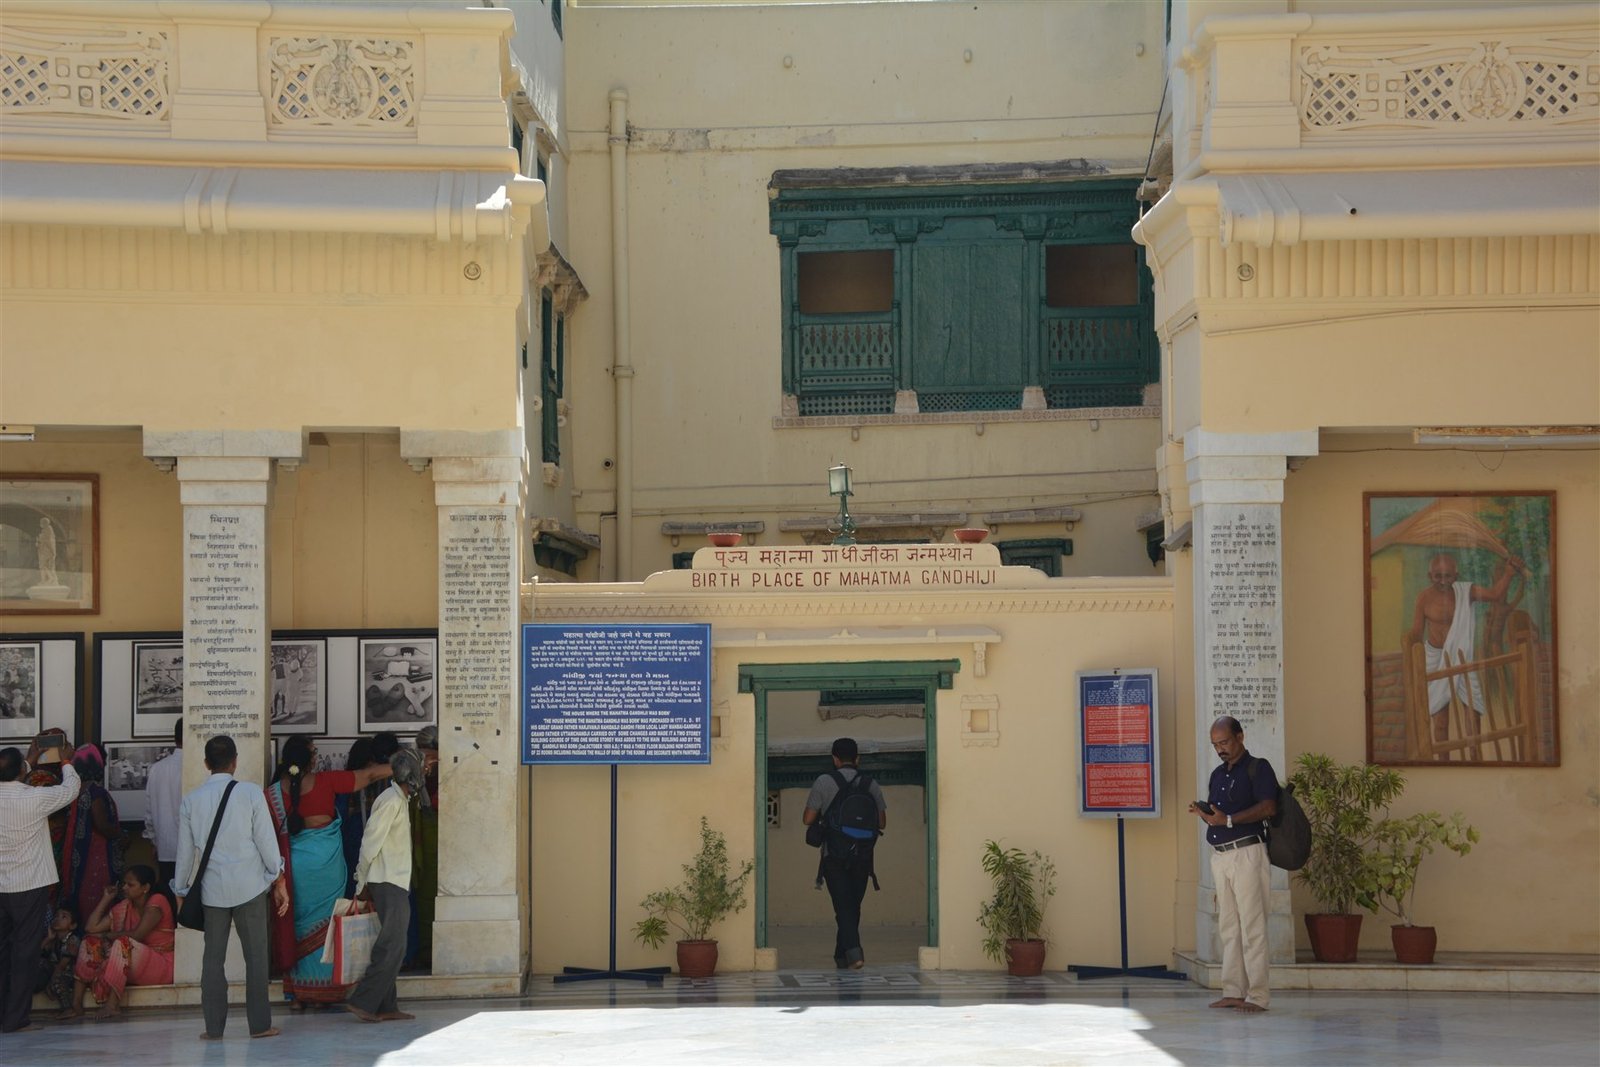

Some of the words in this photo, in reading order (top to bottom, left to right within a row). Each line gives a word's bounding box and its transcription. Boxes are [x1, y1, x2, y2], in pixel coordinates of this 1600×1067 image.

[715, 551, 748, 568] पूज्य
[906, 548, 973, 562] जन्मस्थान
[693, 572, 740, 588] BIRTH
[752, 572, 804, 588] PLACE
[813, 572, 832, 586] OF
[840, 570, 911, 586] MAHATMA
[922, 570, 996, 584] GANDHIJI
